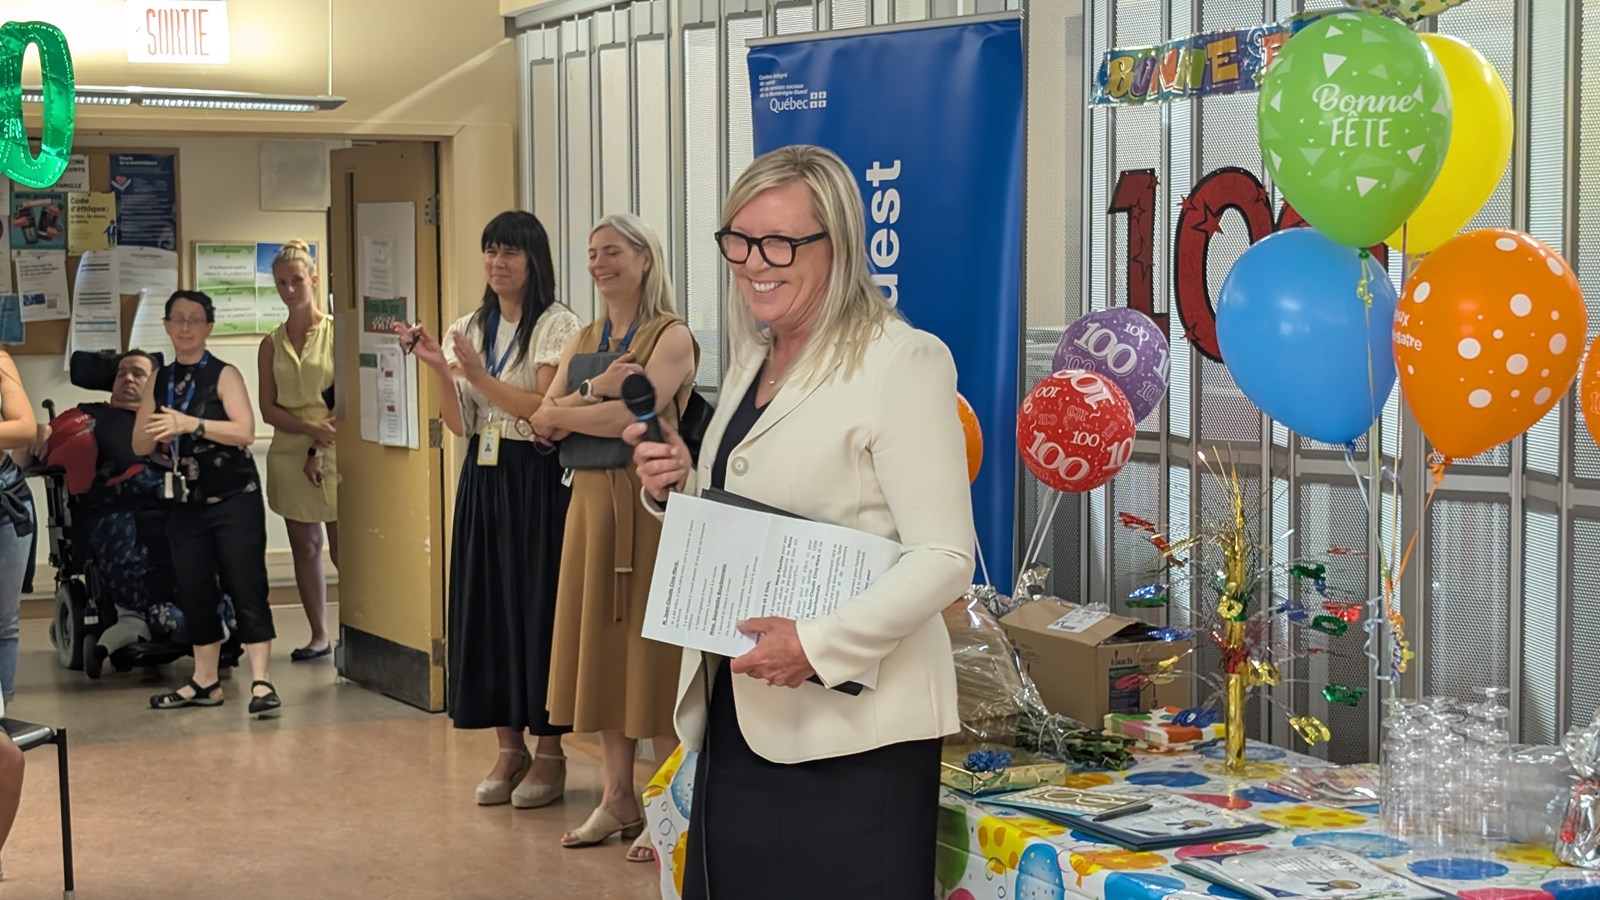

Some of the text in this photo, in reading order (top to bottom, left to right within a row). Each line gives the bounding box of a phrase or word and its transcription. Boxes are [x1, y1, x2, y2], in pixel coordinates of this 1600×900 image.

[146, 8, 210, 56] SORTIE
[1106, 36, 1240, 100] BONNE
[769, 97, 808, 113] Québec
[1312, 82, 1417, 115] Bonne
[1329, 112, 1393, 149] FÊTE
[865, 160, 902, 308] uest
[1074, 322, 1138, 376] 100
[1123, 323, 1149, 343] 100
[1025, 430, 1090, 481] 100
[1070, 430, 1100, 447] 100
